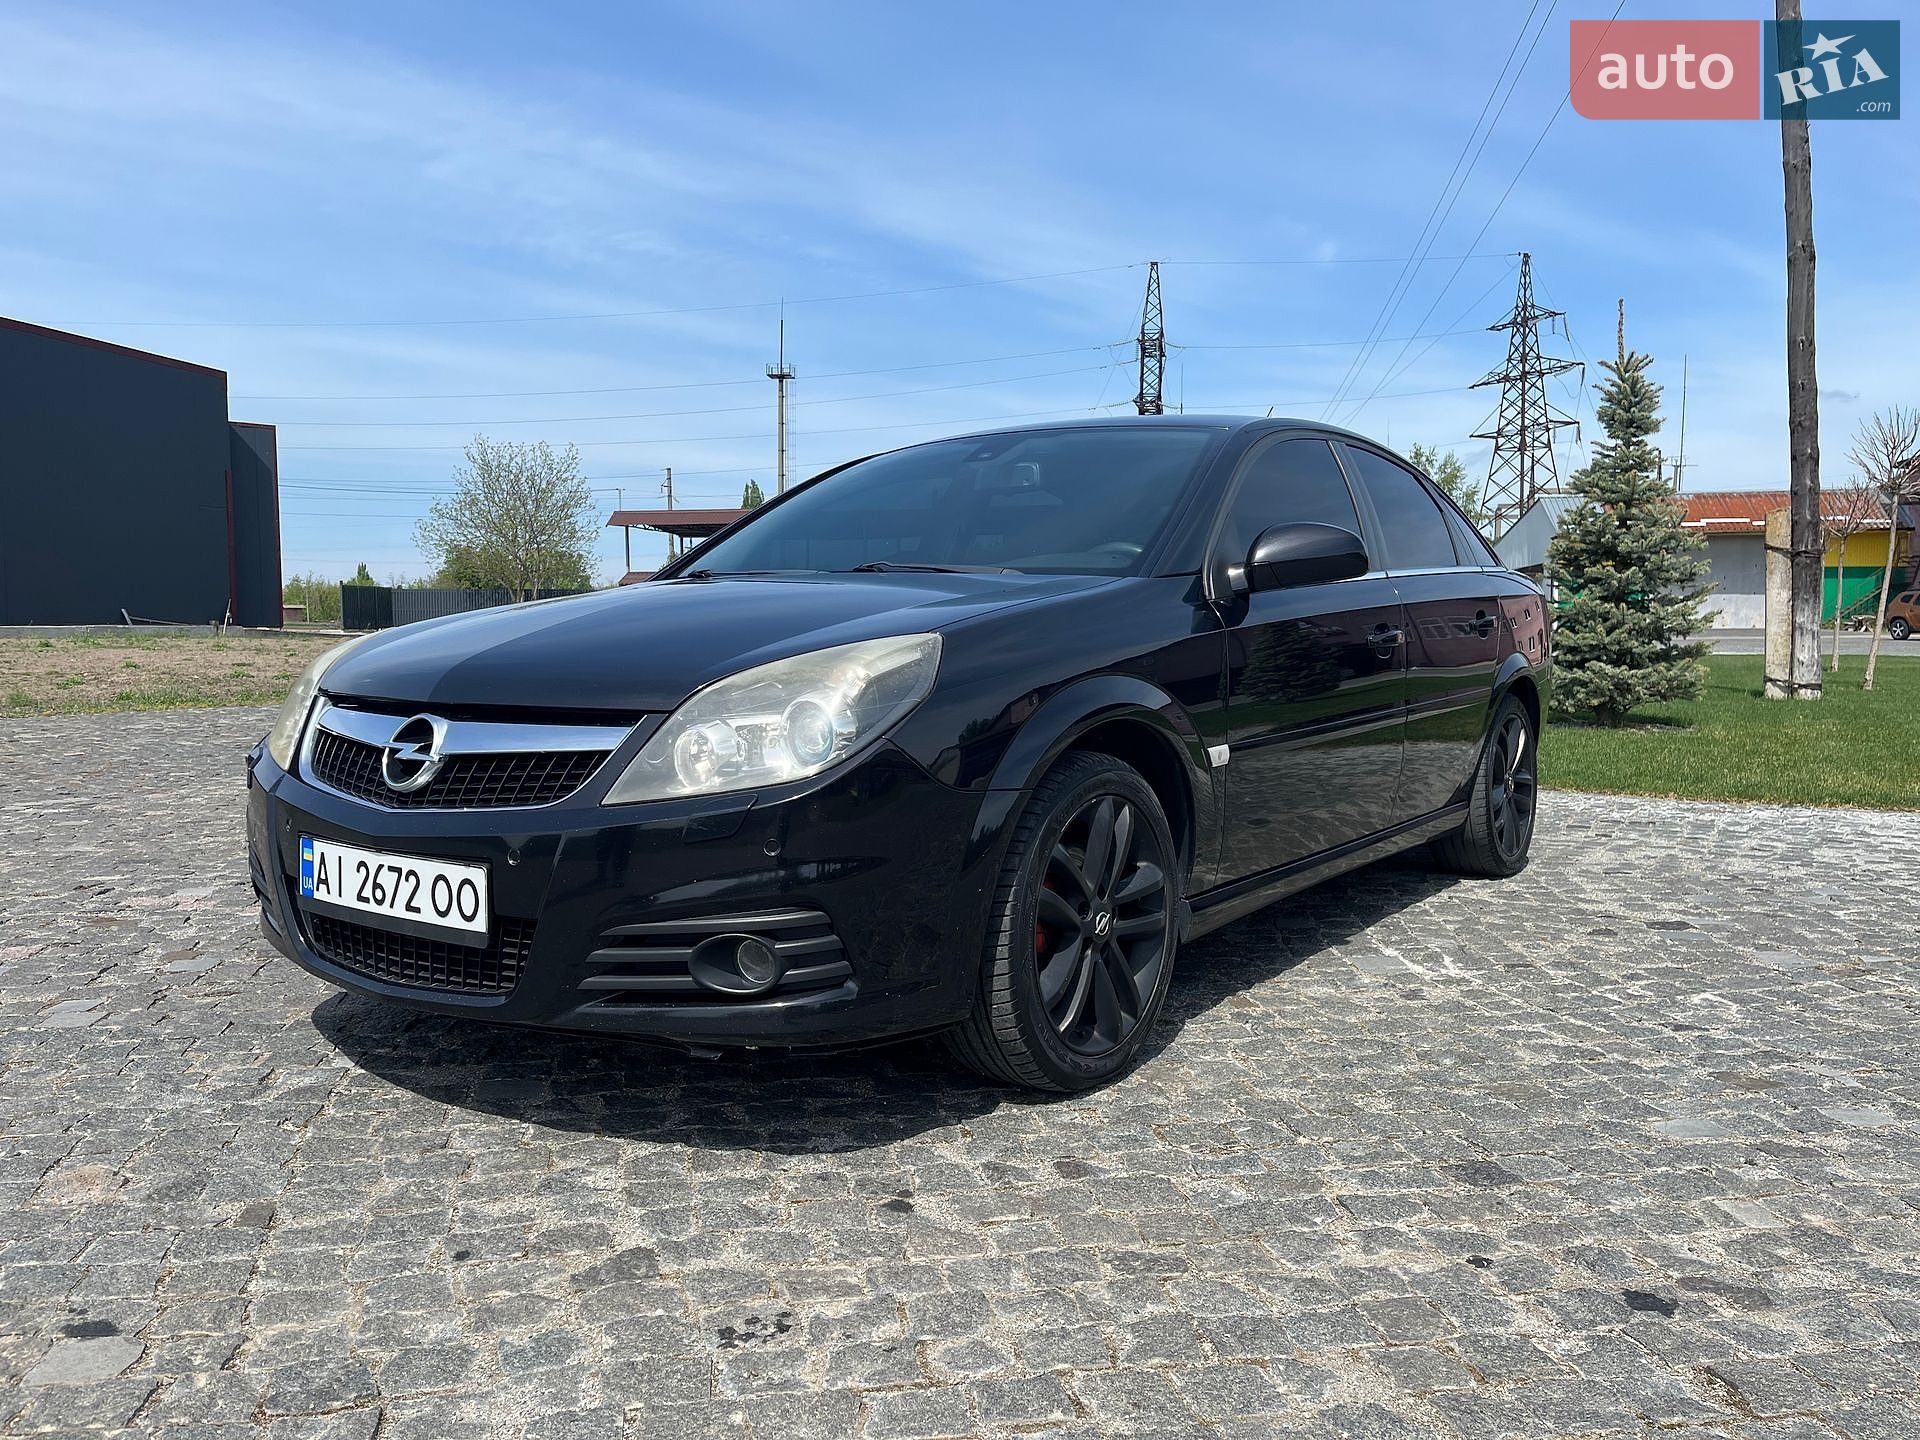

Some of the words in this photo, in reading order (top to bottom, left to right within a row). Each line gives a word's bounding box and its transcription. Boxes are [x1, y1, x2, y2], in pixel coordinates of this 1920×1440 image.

[303, 876, 313, 890] UA
[316, 852, 342, 897] AI
[356, 860, 421, 913] 2672
